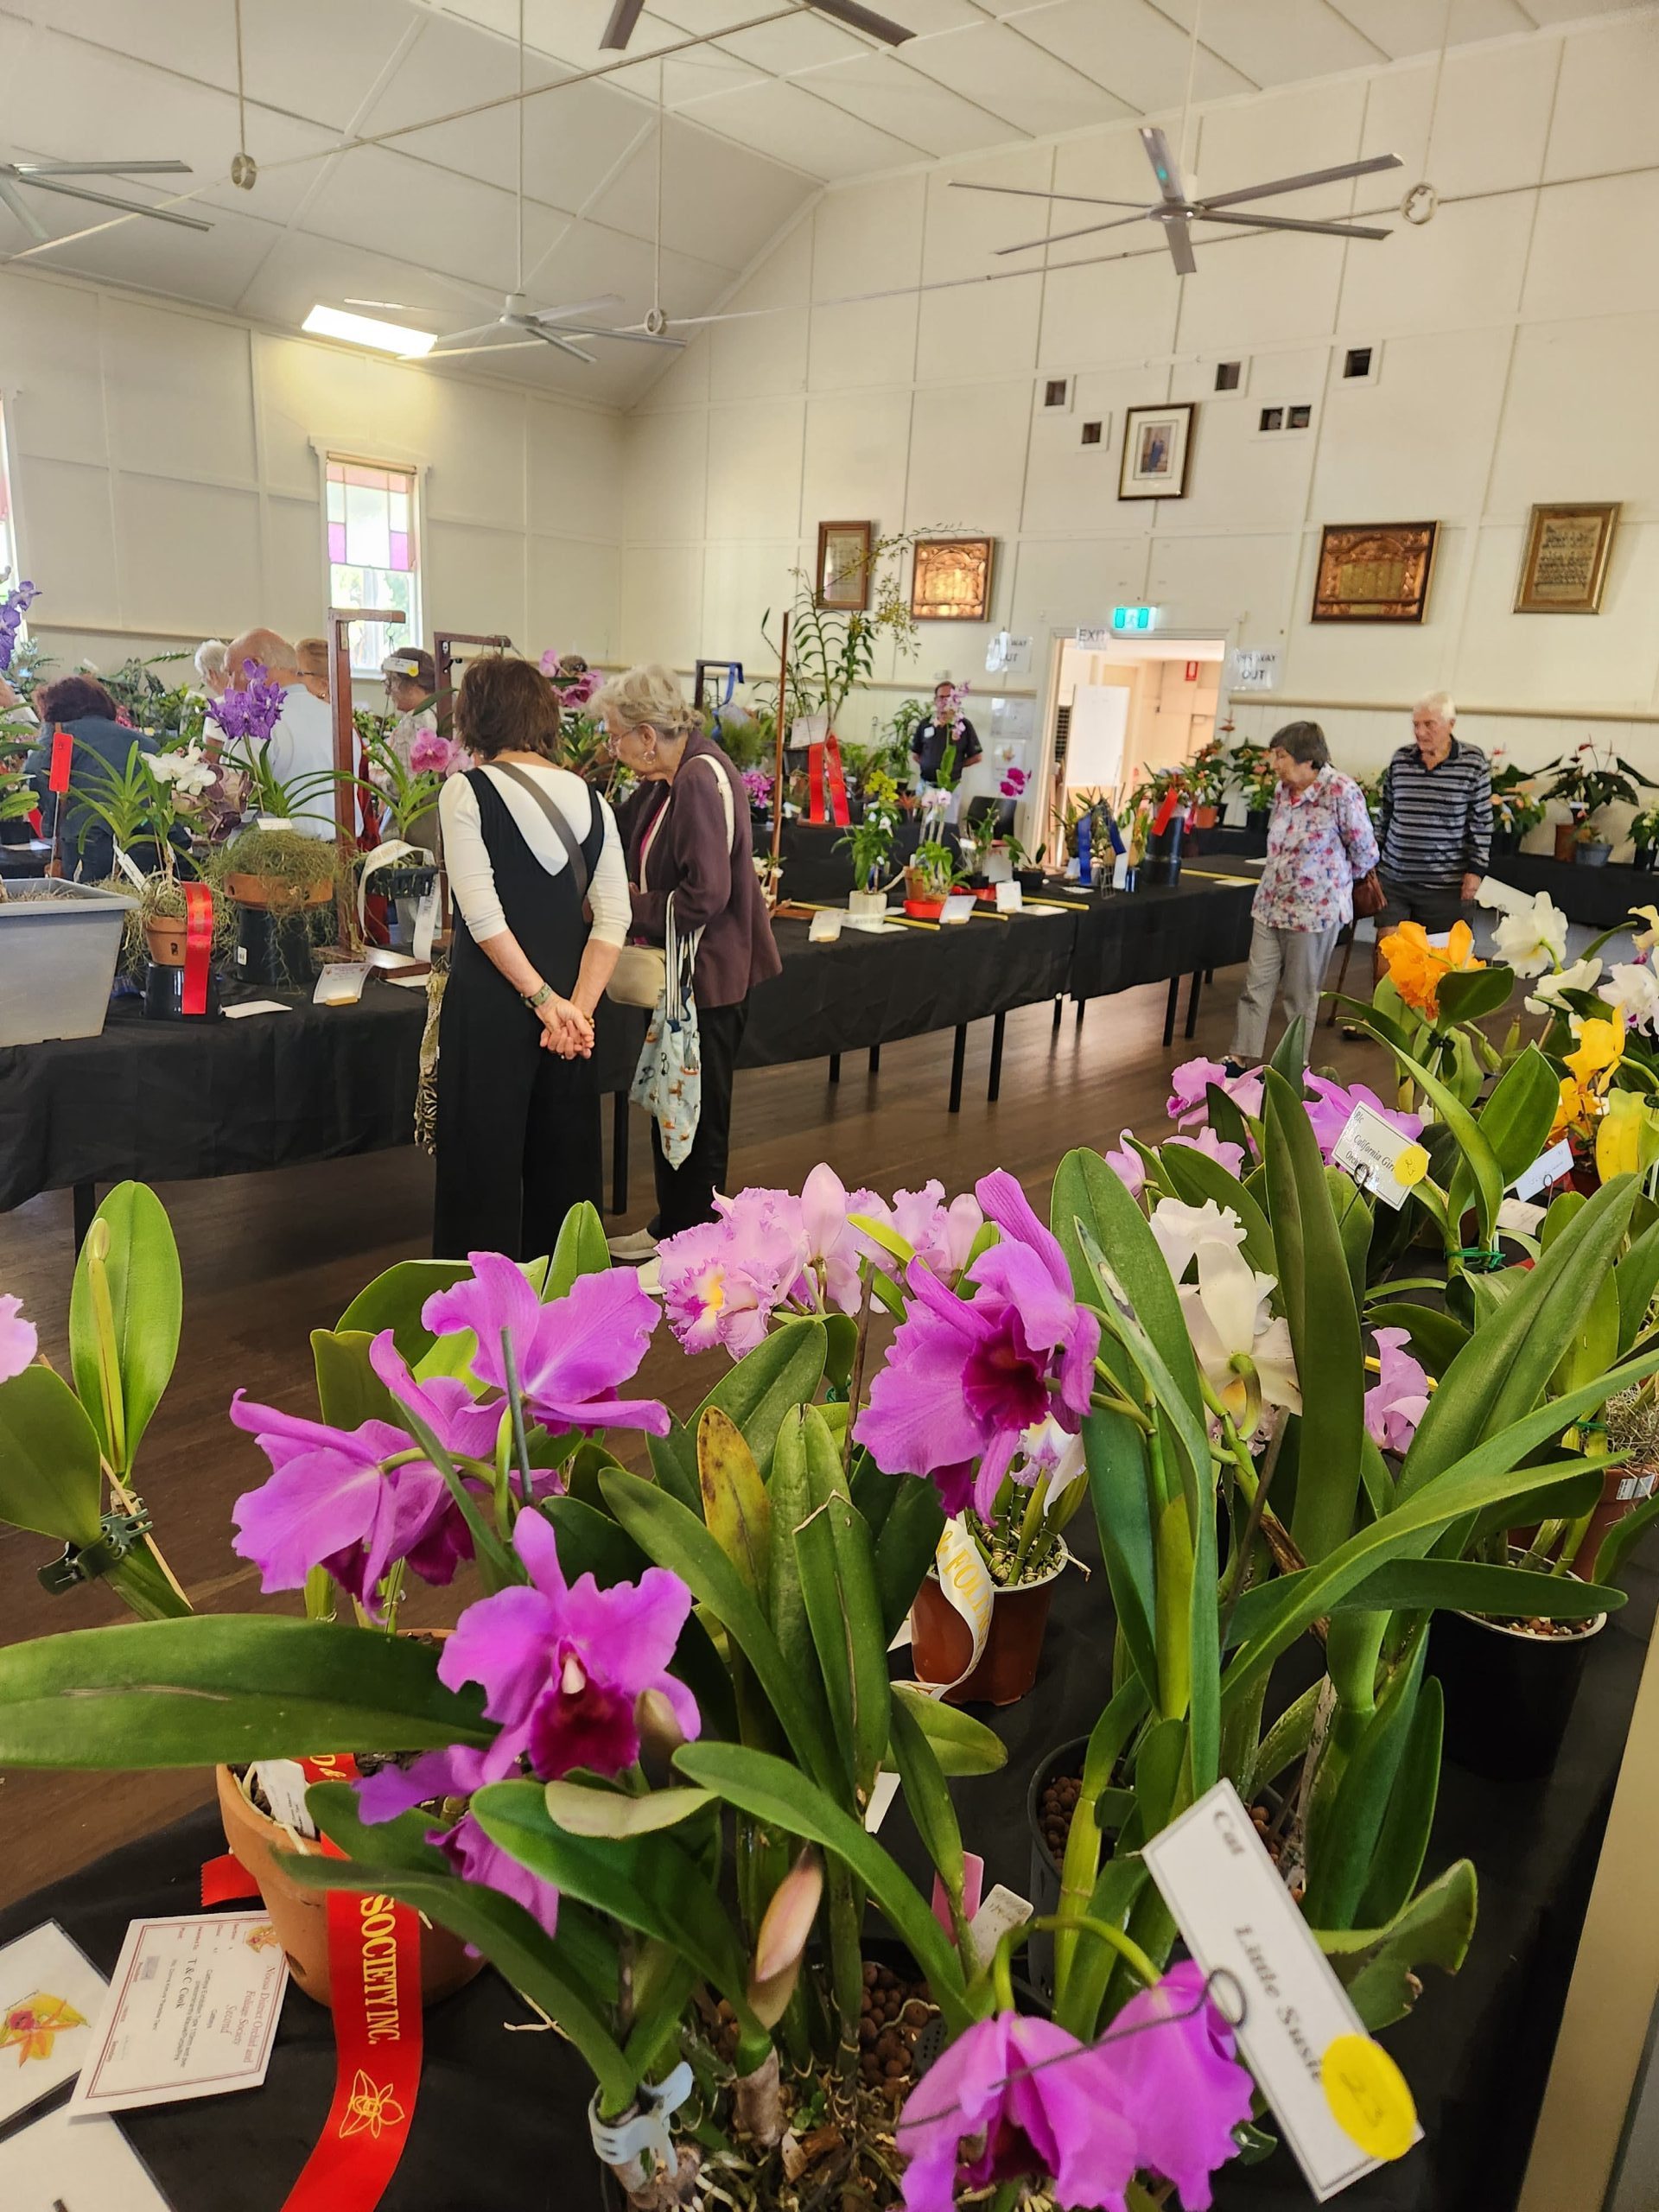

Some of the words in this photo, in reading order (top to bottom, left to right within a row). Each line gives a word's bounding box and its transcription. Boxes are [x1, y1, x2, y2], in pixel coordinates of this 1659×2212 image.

[1242, 669, 1266, 681] OUT
[1354, 1111, 1363, 1124] Rlc
[1353, 1135, 1382, 1162] California
[1213, 1810, 1247, 1857] Cat
[359, 1892, 397, 2006] SOCIETY
[1234, 1924, 1281, 1999] Little
[181, 1975, 193, 1985] C
[183, 1966, 194, 1974] &
[261, 1966, 276, 1990] Noosa
[174, 1986, 190, 2009] Cook
[254, 1993, 270, 2019] District
[188, 2014, 200, 2027] Type
[219, 2004, 237, 2034] Second
[232, 2018, 249, 2045] Society
[365, 2004, 401, 2045] INC.
[246, 2020, 264, 2048] Orchid
[243, 2049, 255, 2063] and
